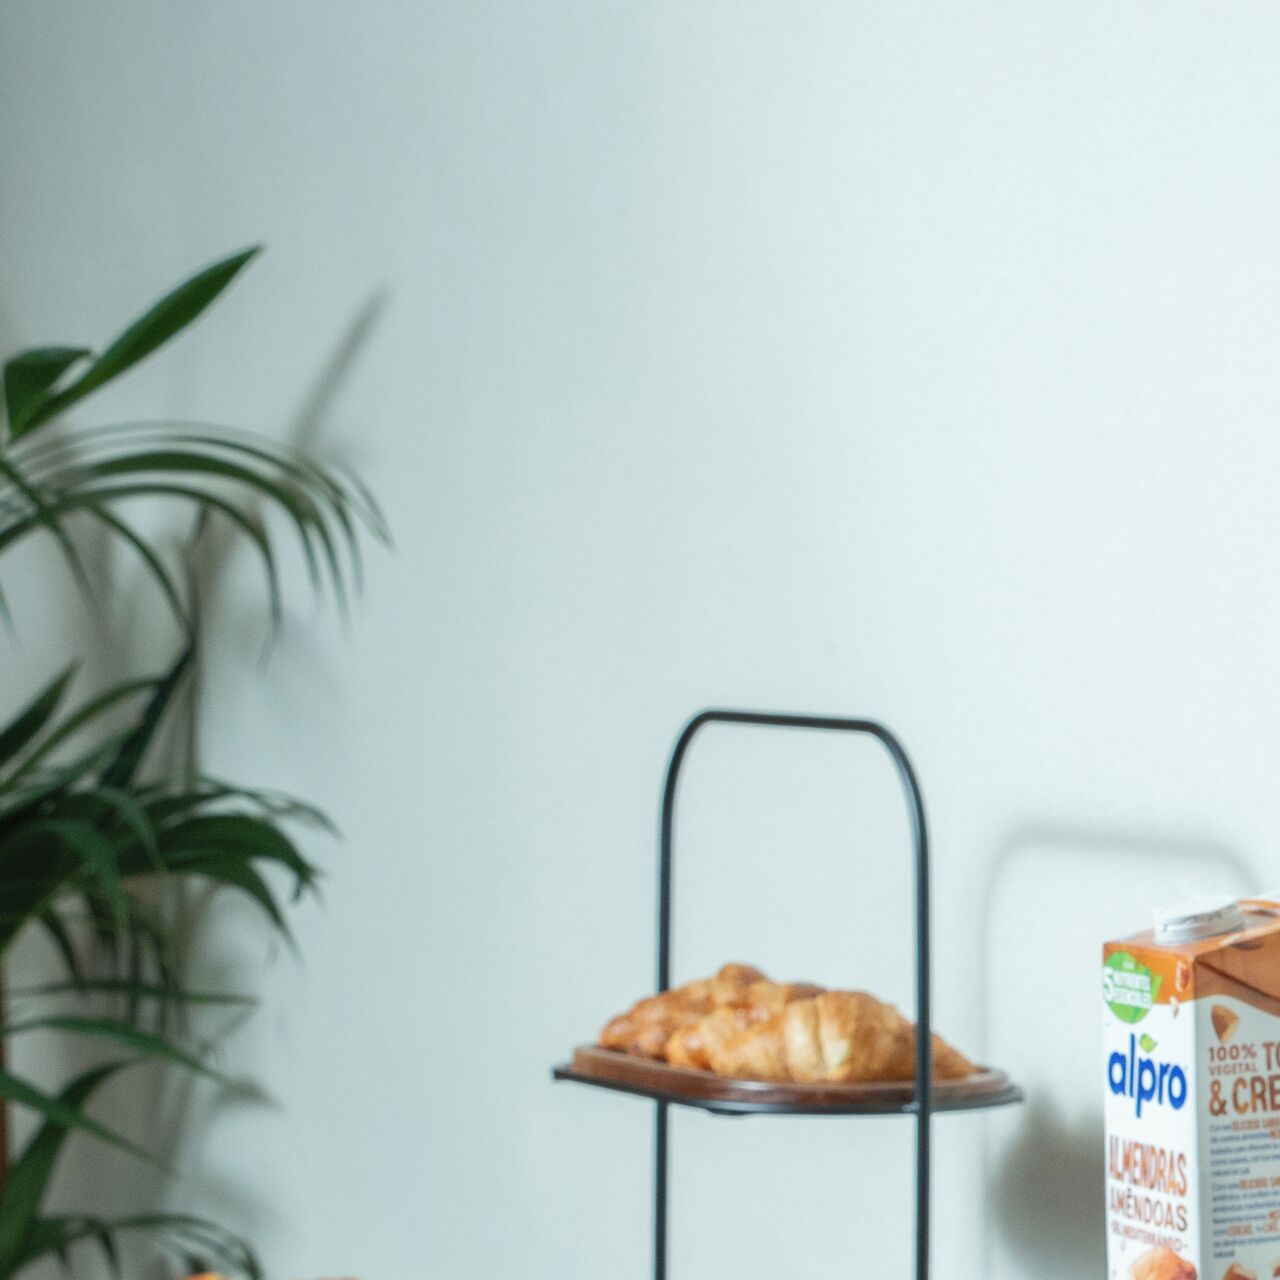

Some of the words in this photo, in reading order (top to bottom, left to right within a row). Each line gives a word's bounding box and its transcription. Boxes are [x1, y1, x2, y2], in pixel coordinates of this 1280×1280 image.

[1209, 1042, 1257, 1062] 100%
[1209, 1062, 1257, 1076] VEGETAL
[1108, 1033, 1187, 1118] alpro
[1209, 1079, 1227, 1116] &
[1109, 1135, 1187, 1197] ALMENDRAS
[1109, 1185, 1188, 1232] AMÊNDOAS
